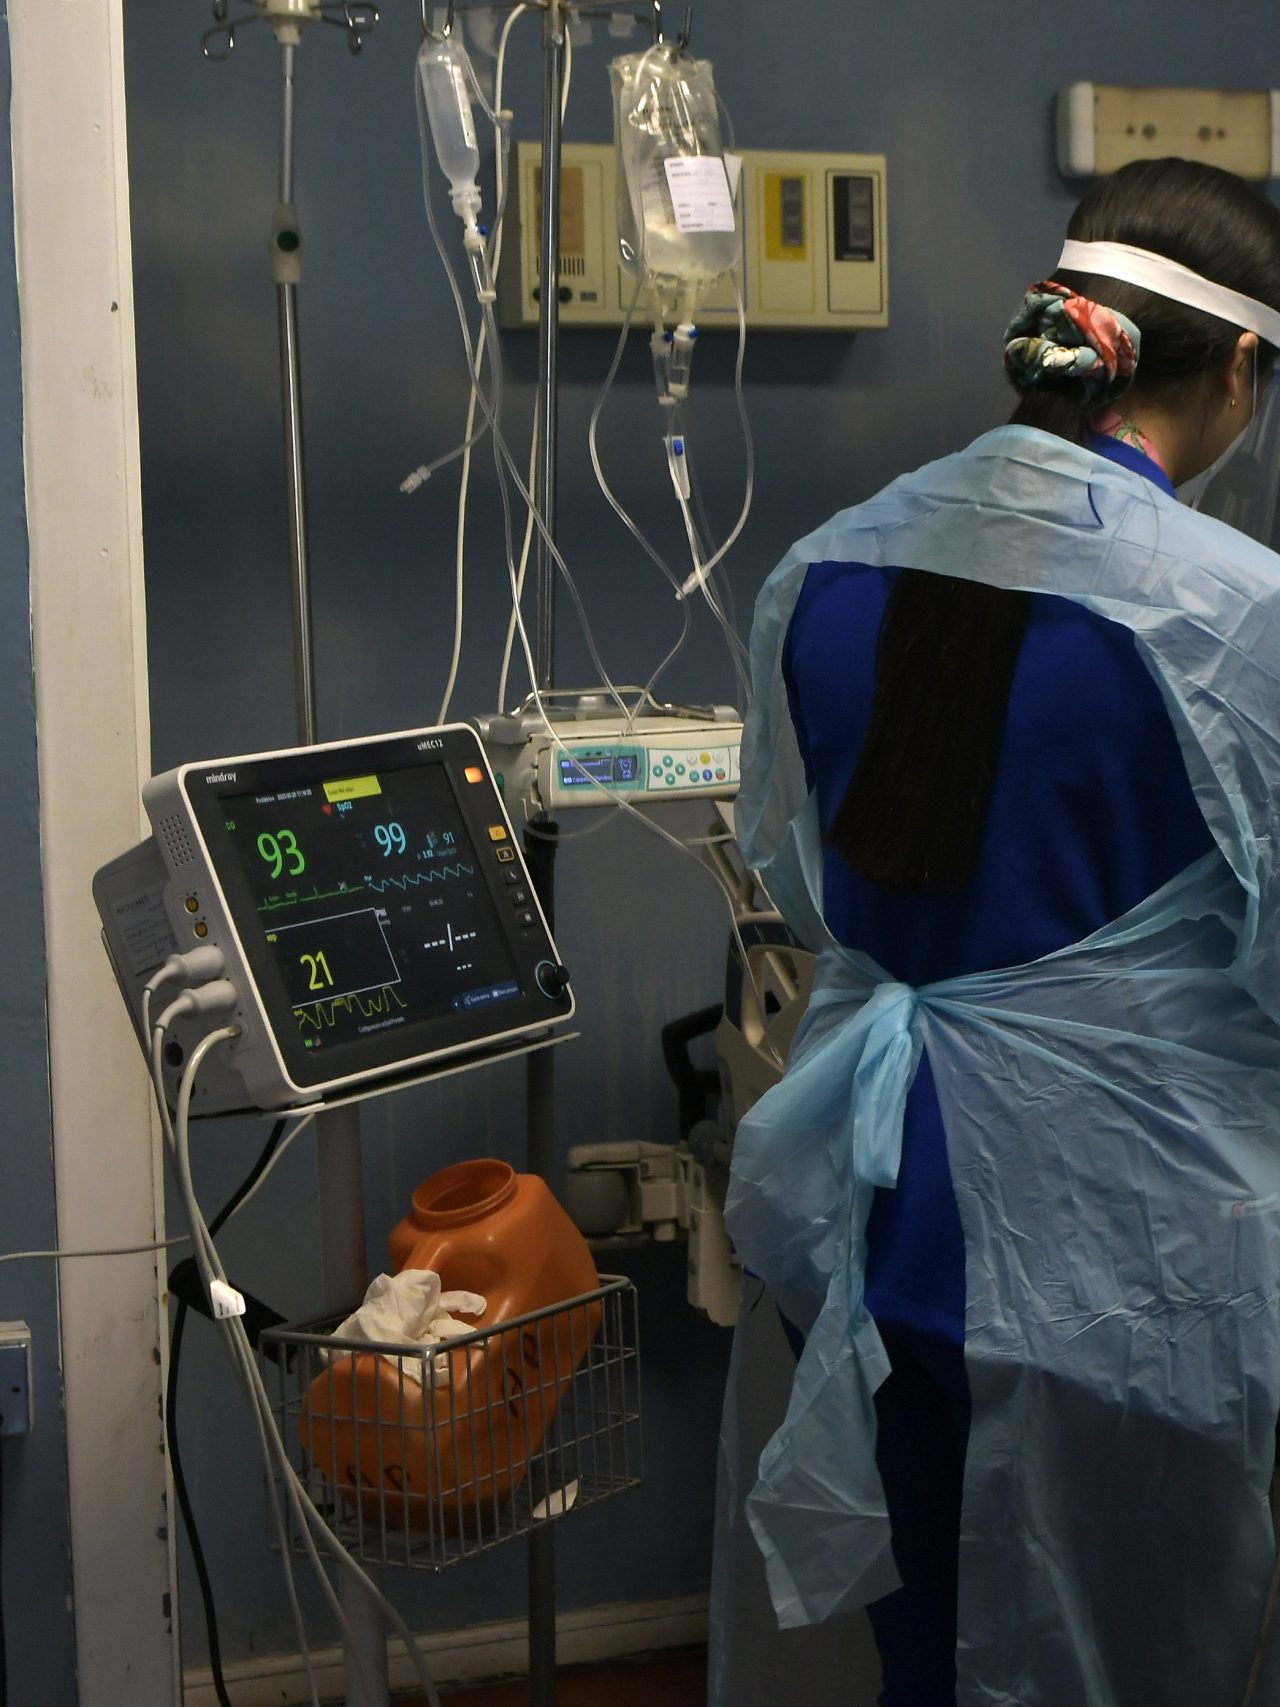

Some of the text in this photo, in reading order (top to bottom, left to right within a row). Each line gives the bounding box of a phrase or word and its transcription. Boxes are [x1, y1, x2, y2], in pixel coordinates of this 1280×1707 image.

[205, 772, 237, 784] mindray
[257, 829, 307, 881] 93
[374, 821, 407, 857] 99
[300, 950, 334, 990] 21
